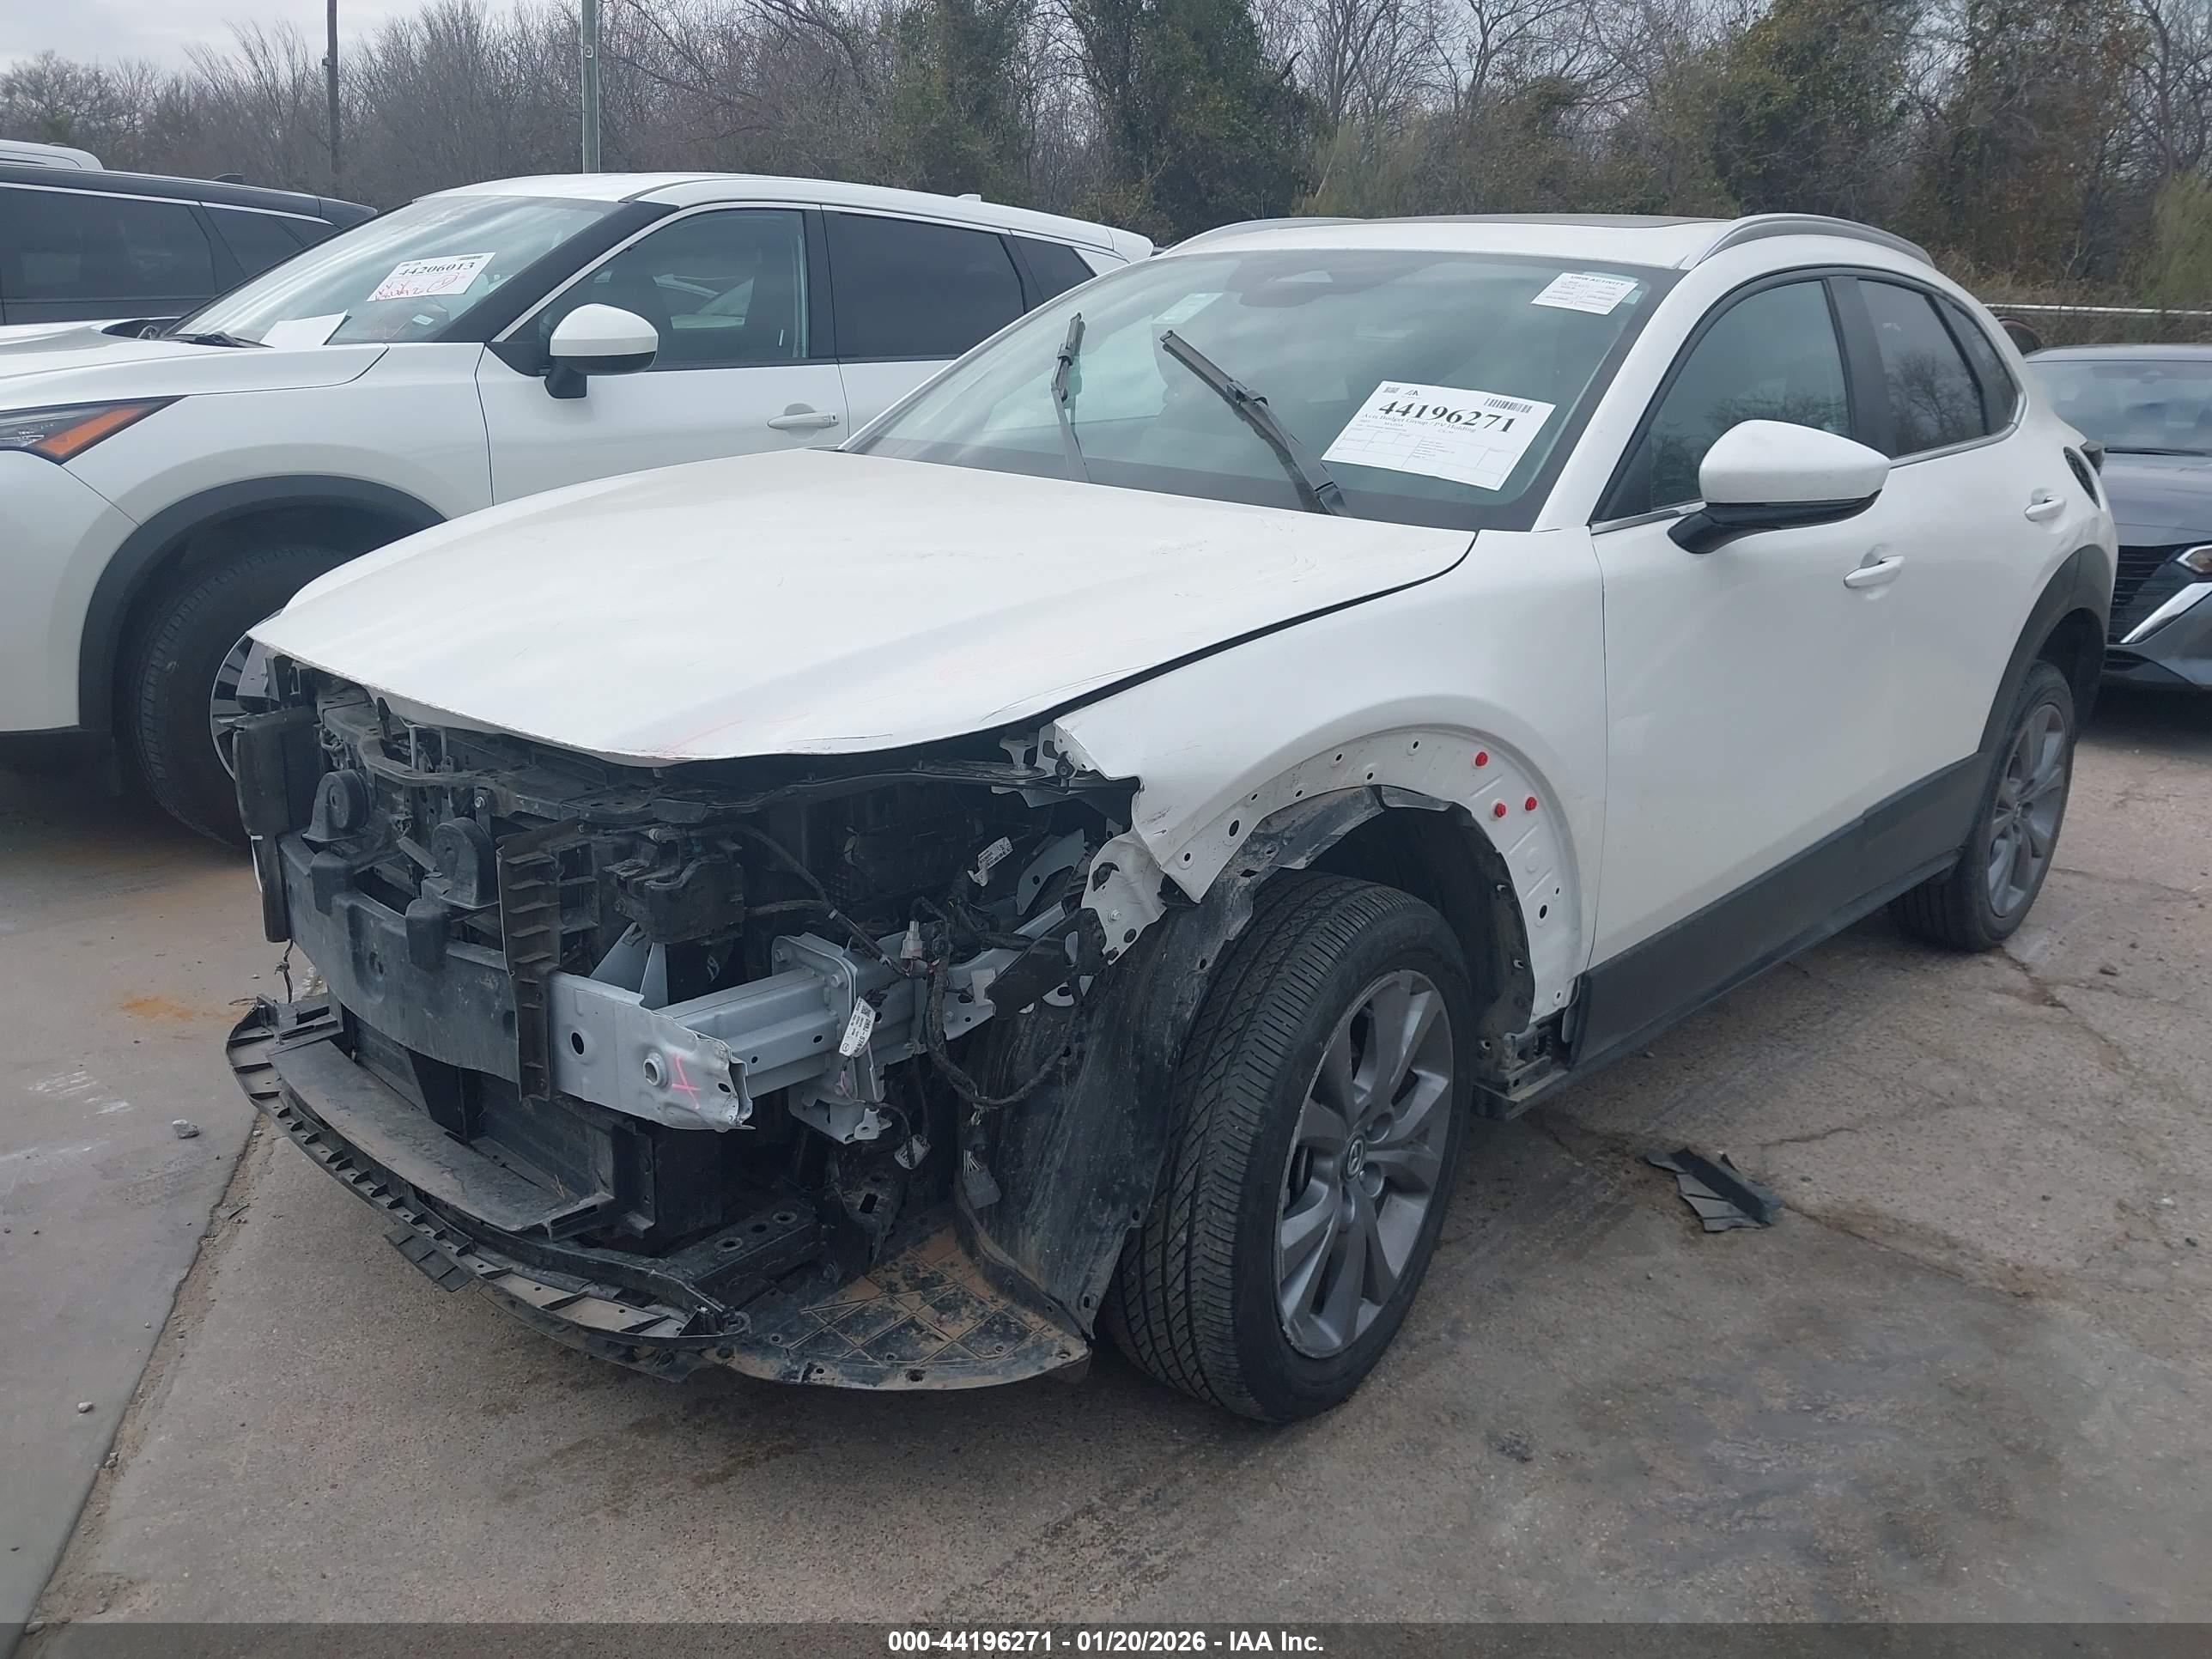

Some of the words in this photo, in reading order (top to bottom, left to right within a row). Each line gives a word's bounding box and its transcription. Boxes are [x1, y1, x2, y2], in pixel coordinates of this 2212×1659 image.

[399, 262, 476, 276] 44206013
[1378, 400, 1516, 434] 44196271
[1379, 415, 1405, 423] Budget
[1406, 417, 1429, 426] Group
[1447, 423, 1477, 433] Holding
